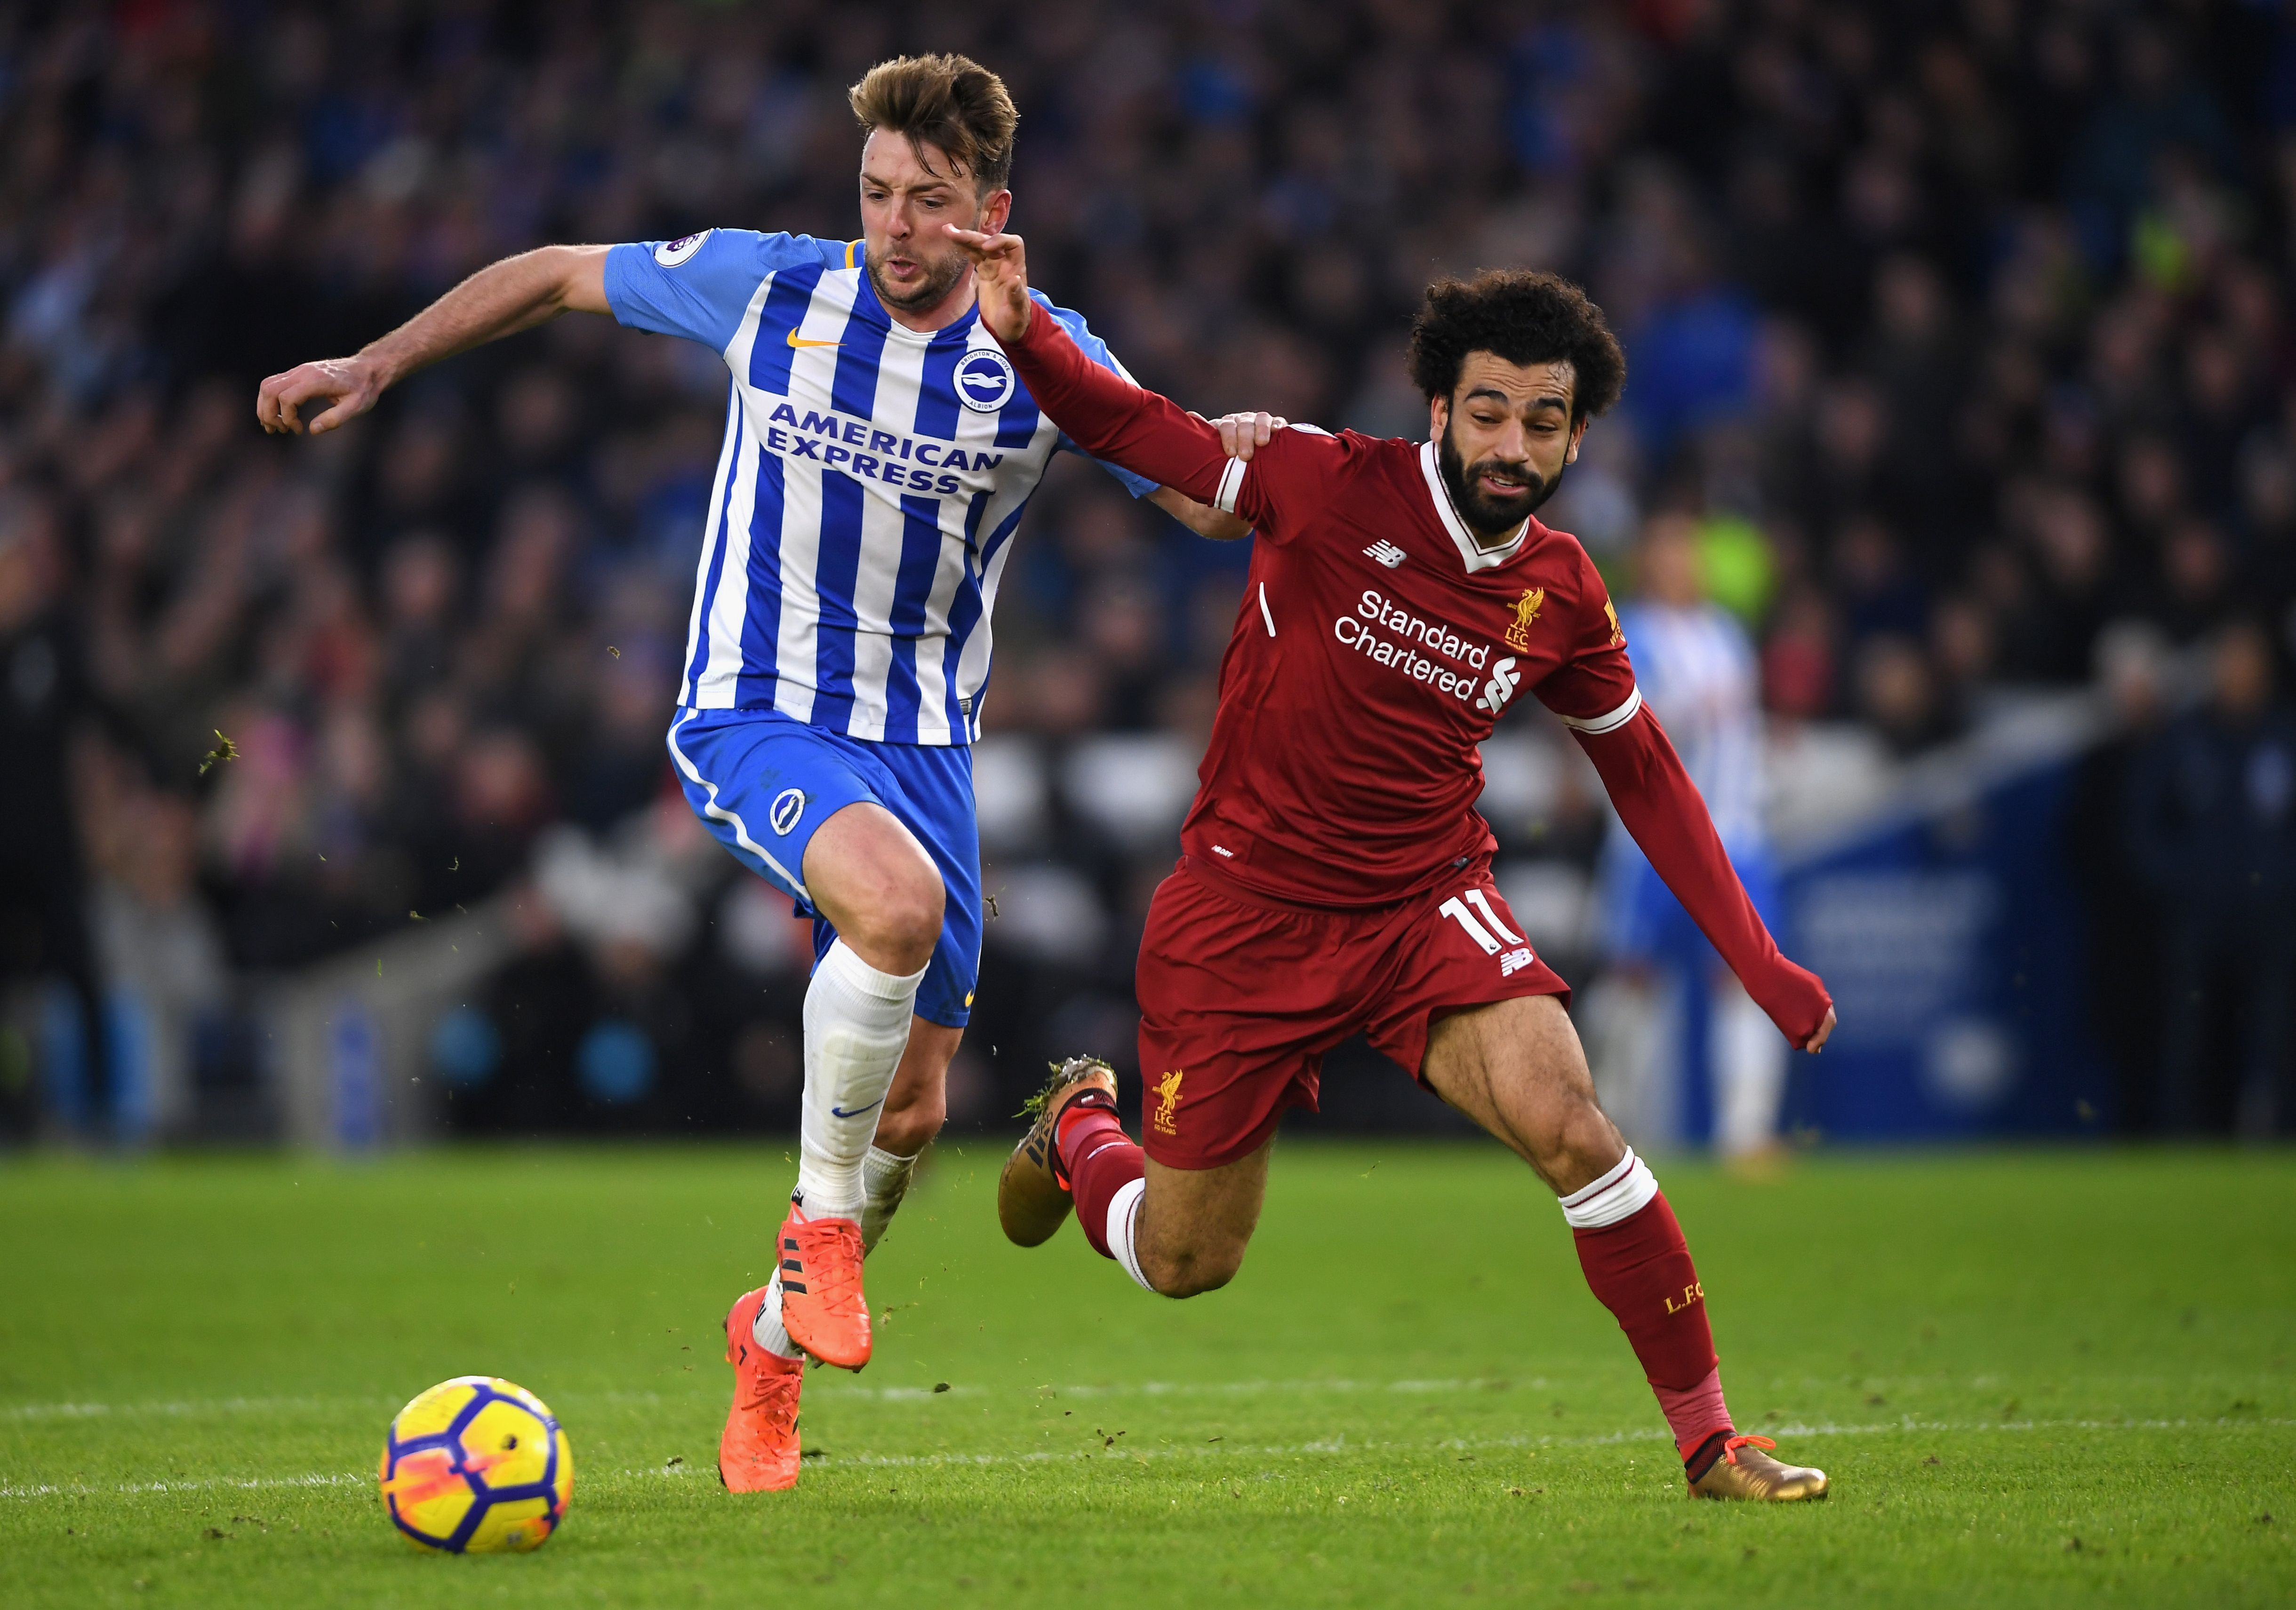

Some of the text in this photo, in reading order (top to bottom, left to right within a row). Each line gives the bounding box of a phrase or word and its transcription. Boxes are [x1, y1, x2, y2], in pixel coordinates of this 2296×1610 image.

[960, 351, 990, 366] BRIGHTON
[999, 358, 1011, 372] HOVE
[769, 402, 1003, 471] AMERICAN
[969, 401, 992, 409] ALBION
[767, 426, 961, 494] EXPRESS
[1335, 616, 1478, 701] Chartered
[1357, 590, 1490, 670] Standard
[1438, 888, 1525, 956] 11
